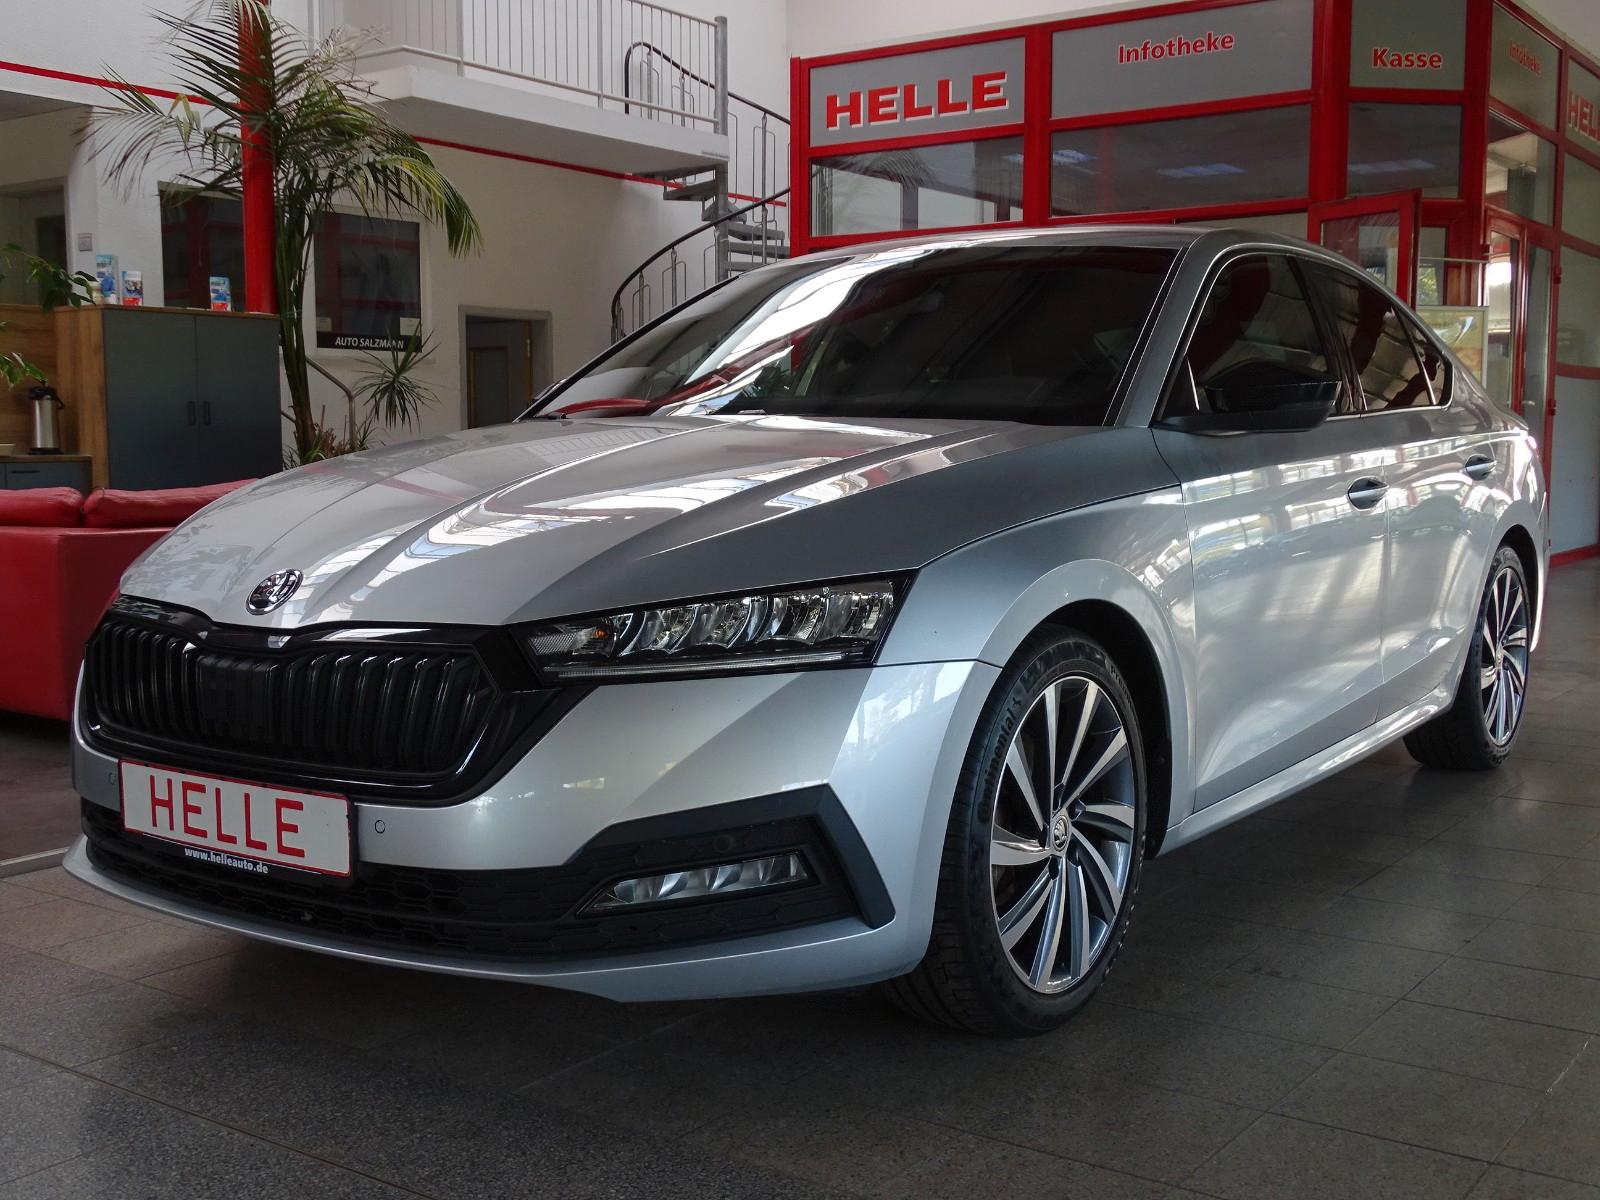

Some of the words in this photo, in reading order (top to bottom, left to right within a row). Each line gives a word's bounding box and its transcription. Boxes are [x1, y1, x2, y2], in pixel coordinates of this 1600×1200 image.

[1118, 31, 1235, 64] Infotheke
[1372, 46, 1443, 70] Kasse
[826, 71, 1009, 131] HELLE
[335, 336, 359, 347] AUTO
[149, 774, 305, 858] HELLE
[184, 847, 269, 874] www.helleauto.de
